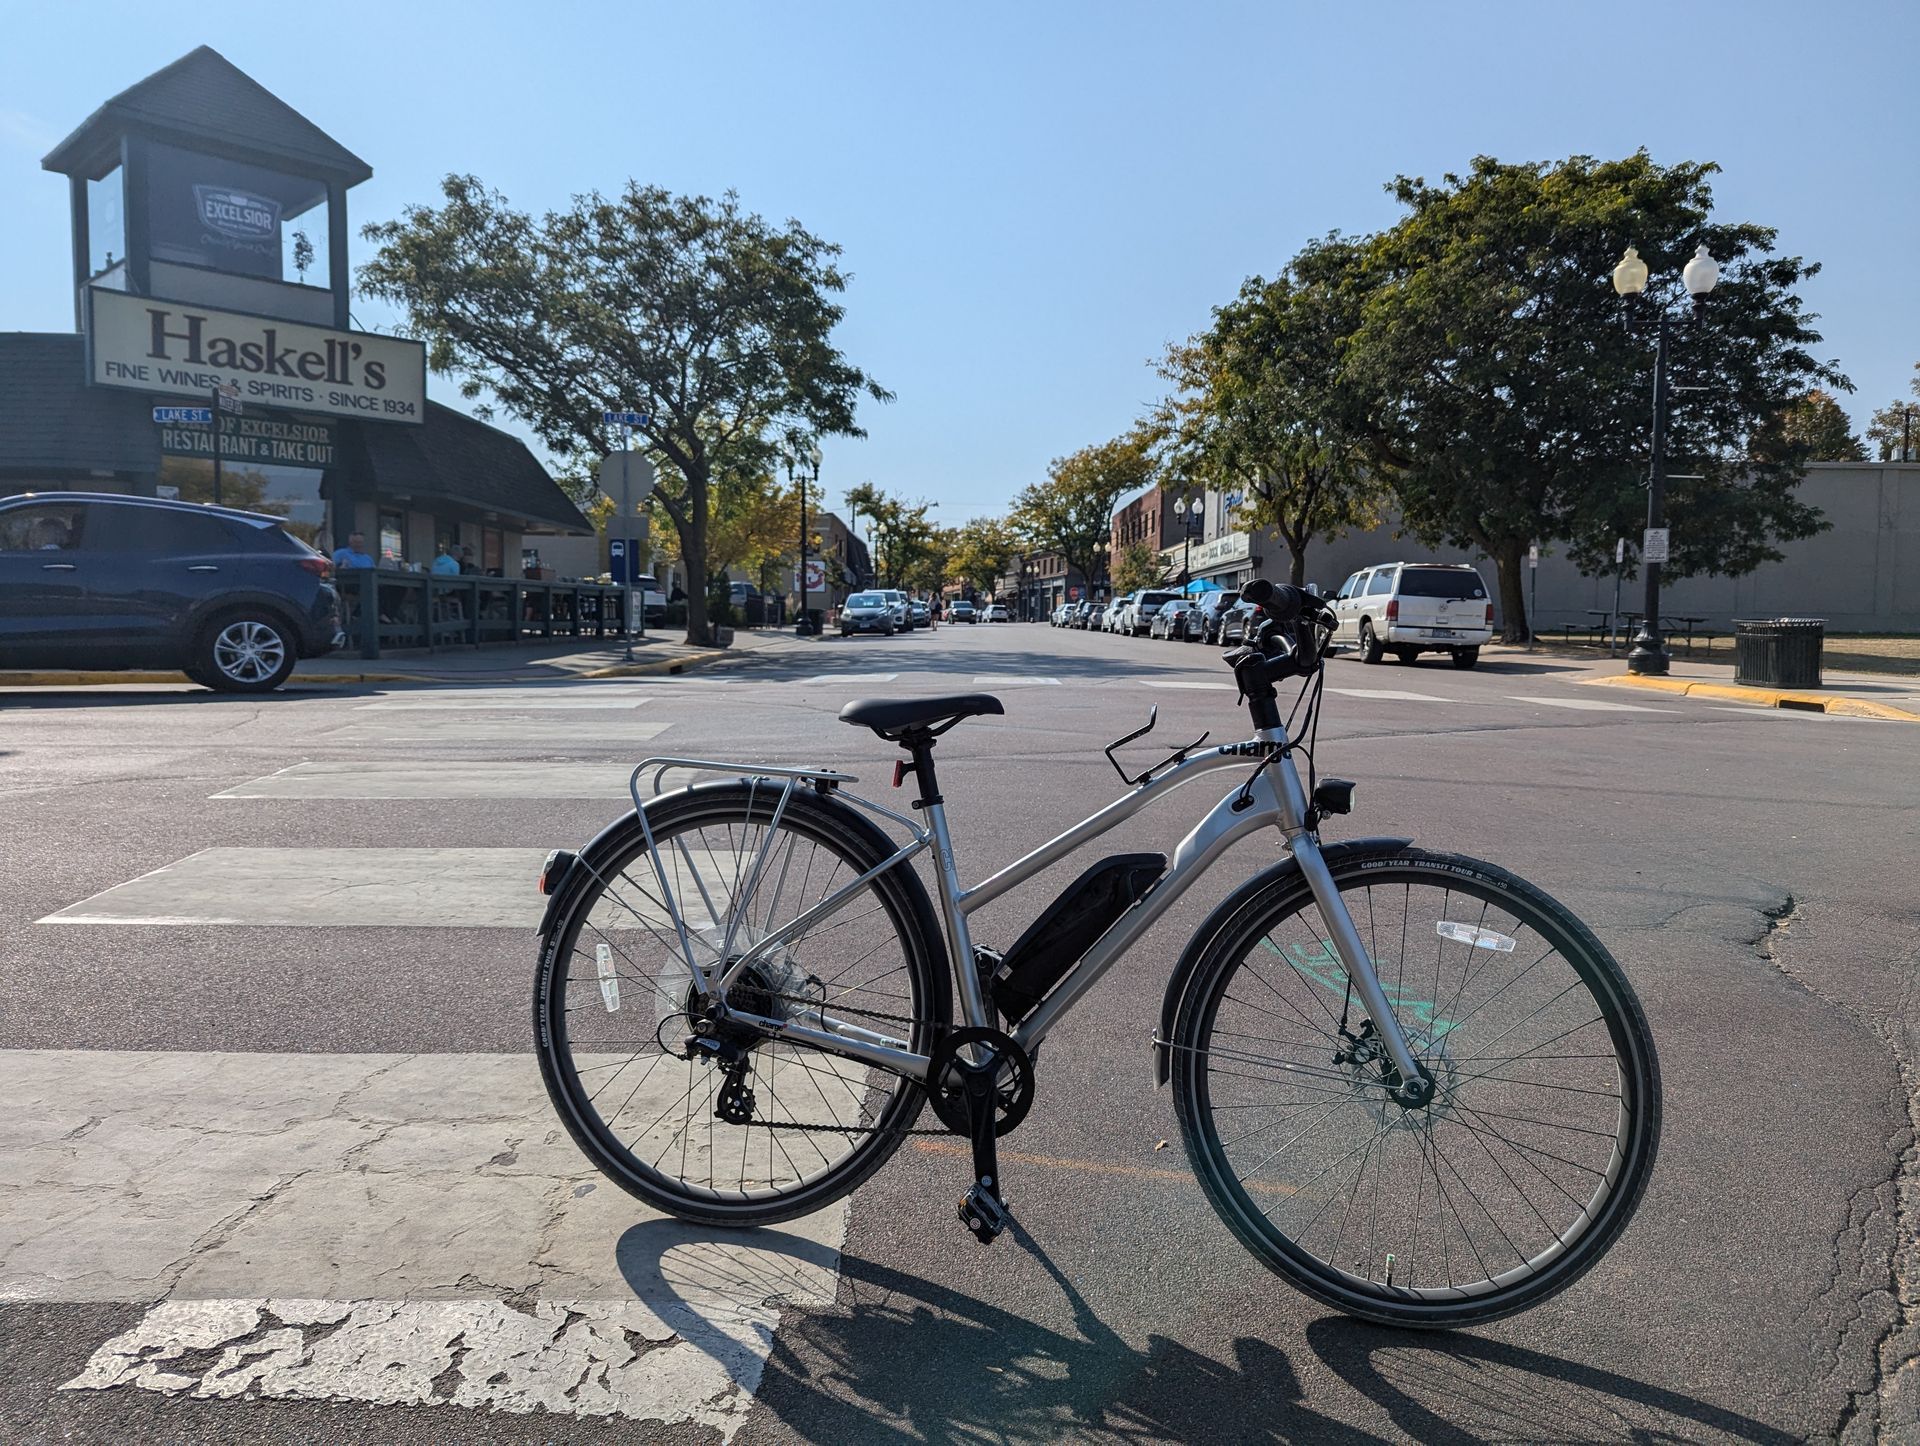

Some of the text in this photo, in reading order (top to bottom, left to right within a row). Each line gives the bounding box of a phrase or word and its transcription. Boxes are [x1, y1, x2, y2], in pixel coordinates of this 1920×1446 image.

[205, 199, 272, 230] EXCELSIOR
[146, 308, 387, 390] Haskell's
[105, 360, 149, 381] FINE
[158, 367, 221, 389] WINES
[247, 380, 313, 402] SPIRITS
[329, 391, 379, 411] SINCE
[383, 399, 415, 416] 1934
[161, 408, 205, 420] LAKE ST
[240, 419, 330, 443] EXCELSIOR
[260, 443, 269, 456] &
[271, 440, 305, 461] TAKE
[307, 444, 334, 463] OUT
[1414, 860, 1450, 870] TRANSIT
[1451, 865, 1474, 877] TOUR
[544, 948, 553, 968] TOUR
[759, 1020, 783, 1031] charge
